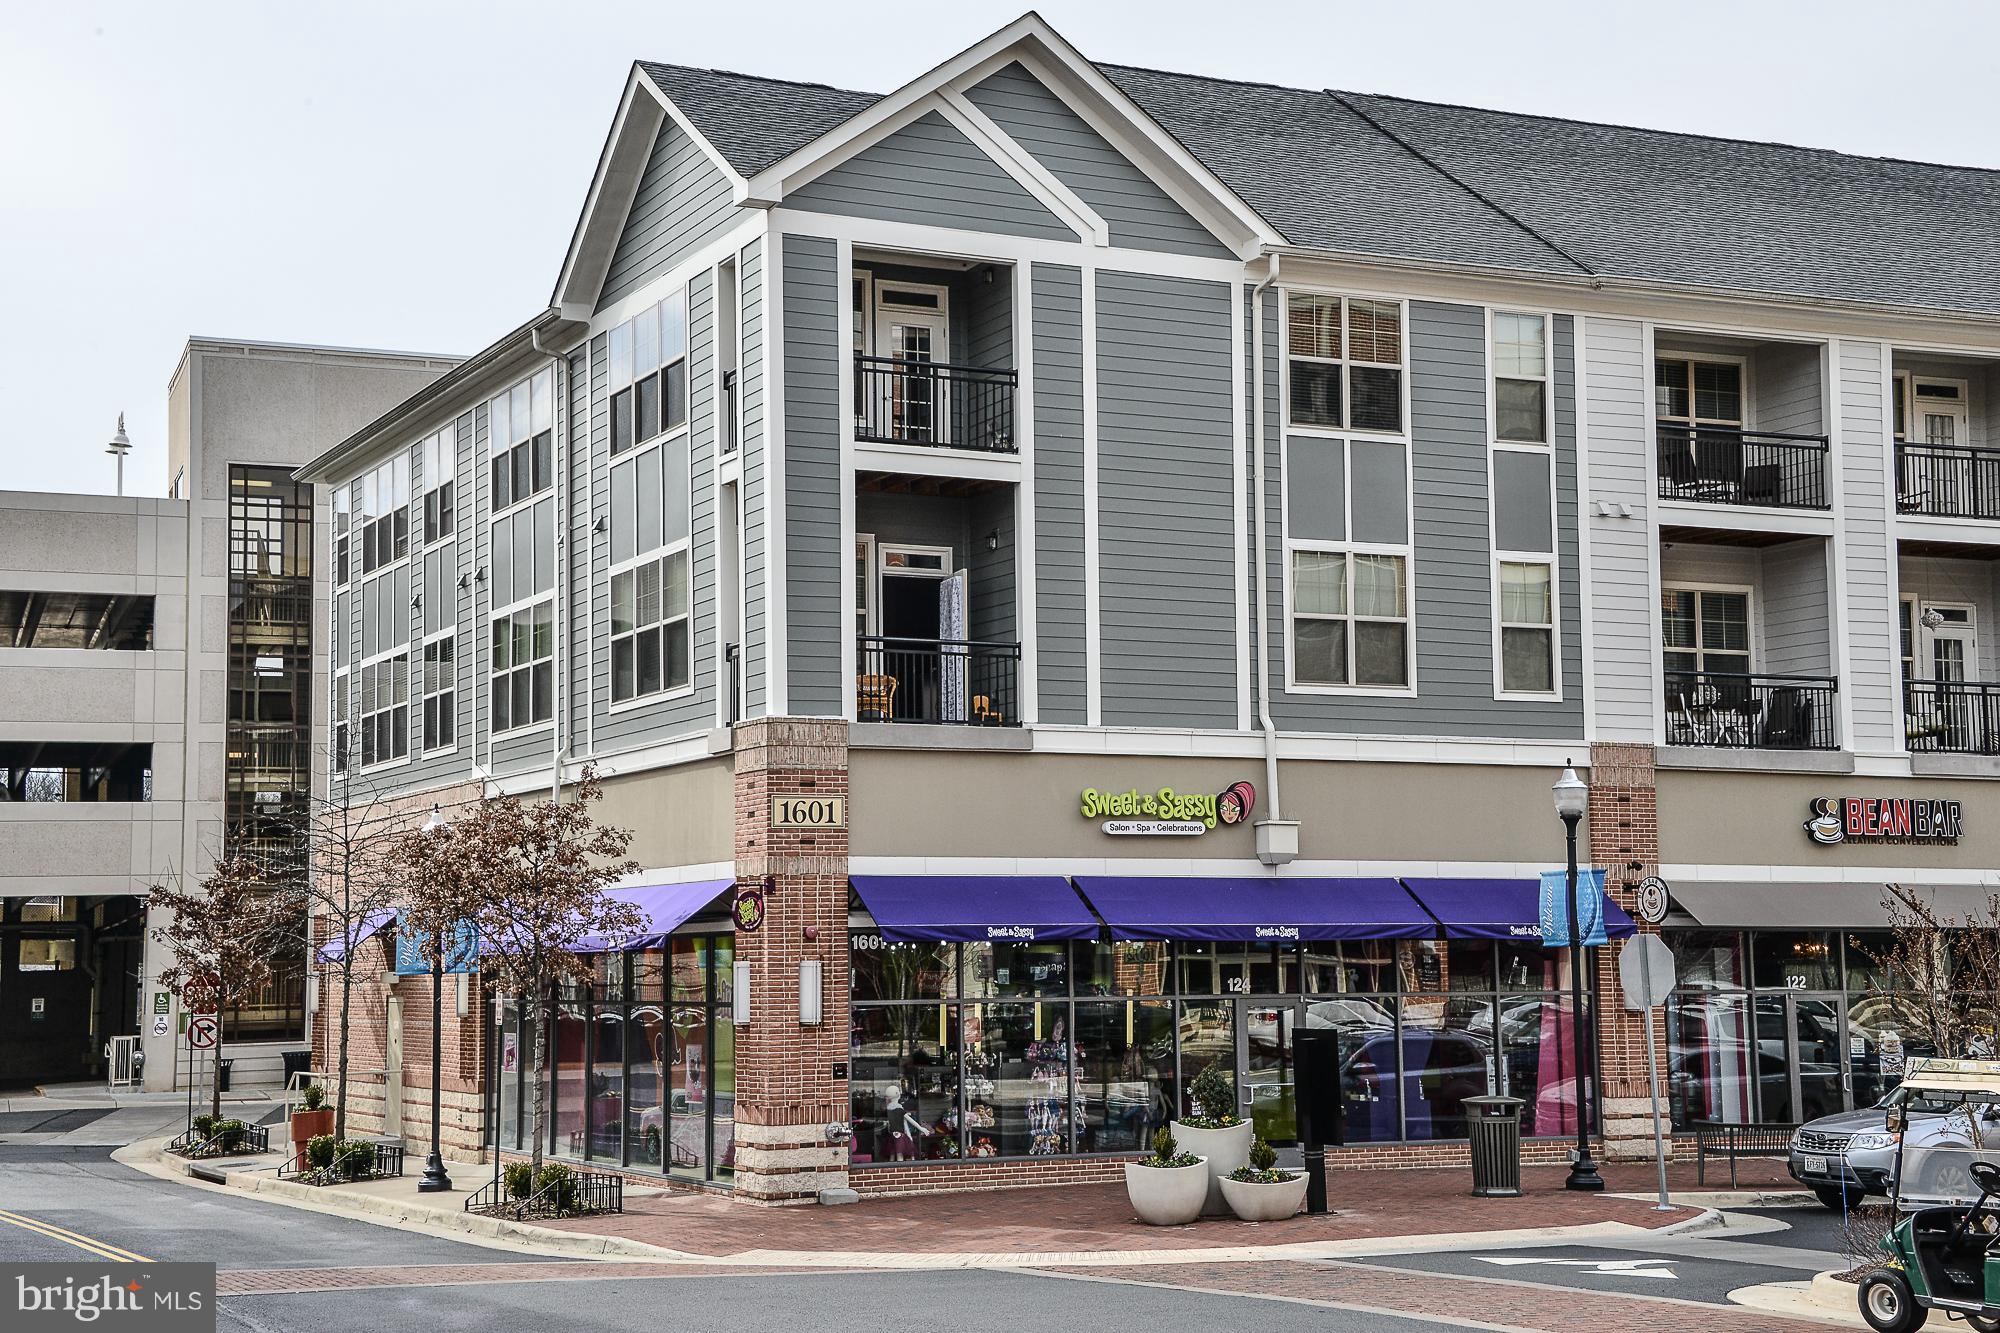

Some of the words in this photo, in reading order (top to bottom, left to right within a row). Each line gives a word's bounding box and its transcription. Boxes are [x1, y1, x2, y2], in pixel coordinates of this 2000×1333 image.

[780, 800, 836, 823] 1601
[1080, 787, 1140, 818] Sweet
[1141, 795, 1157, 816] &
[1157, 787, 1217, 829] Sassy
[1846, 798, 1911, 836] BEAN
[1914, 800, 1964, 837] BAR
[1109, 823, 1130, 832] Salon
[1136, 823, 1151, 832] Spa
[1156, 823, 1203, 832] Celebrations
[1841, 836, 1883, 846] CREATING
[1886, 836, 1959, 847] CONVERSATIONS
[1542, 881, 1554, 936] Welcome
[987, 926, 1008, 937] Sweet
[1013, 925, 1035, 940] Sassy
[1255, 926, 1274, 937] Sweet
[1279, 925, 1299, 940] Sassy
[1227, 977, 1251, 992] 124
[1785, 975, 1807, 989] 122
